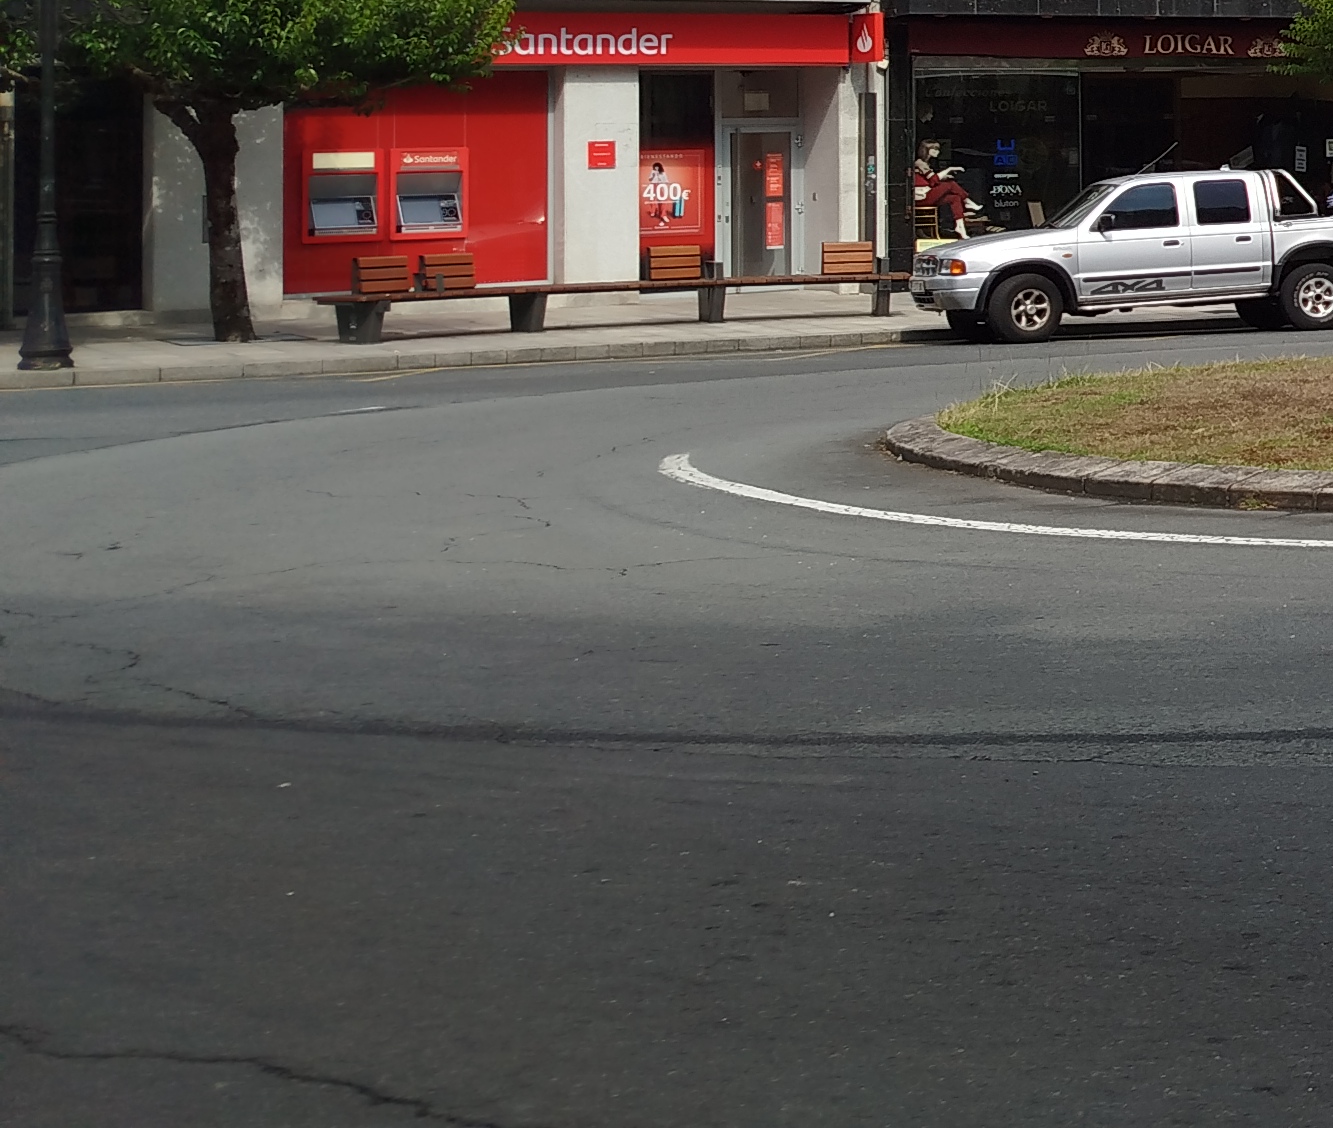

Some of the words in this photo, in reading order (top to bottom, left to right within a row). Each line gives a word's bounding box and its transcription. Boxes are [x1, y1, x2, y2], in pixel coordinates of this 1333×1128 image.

[1144, 34, 1235, 55] LOIGAR
[990, 100, 1048, 112] LOIGAR
[414, 155, 457, 163] Santander
[642, 183, 691, 201] 400€
